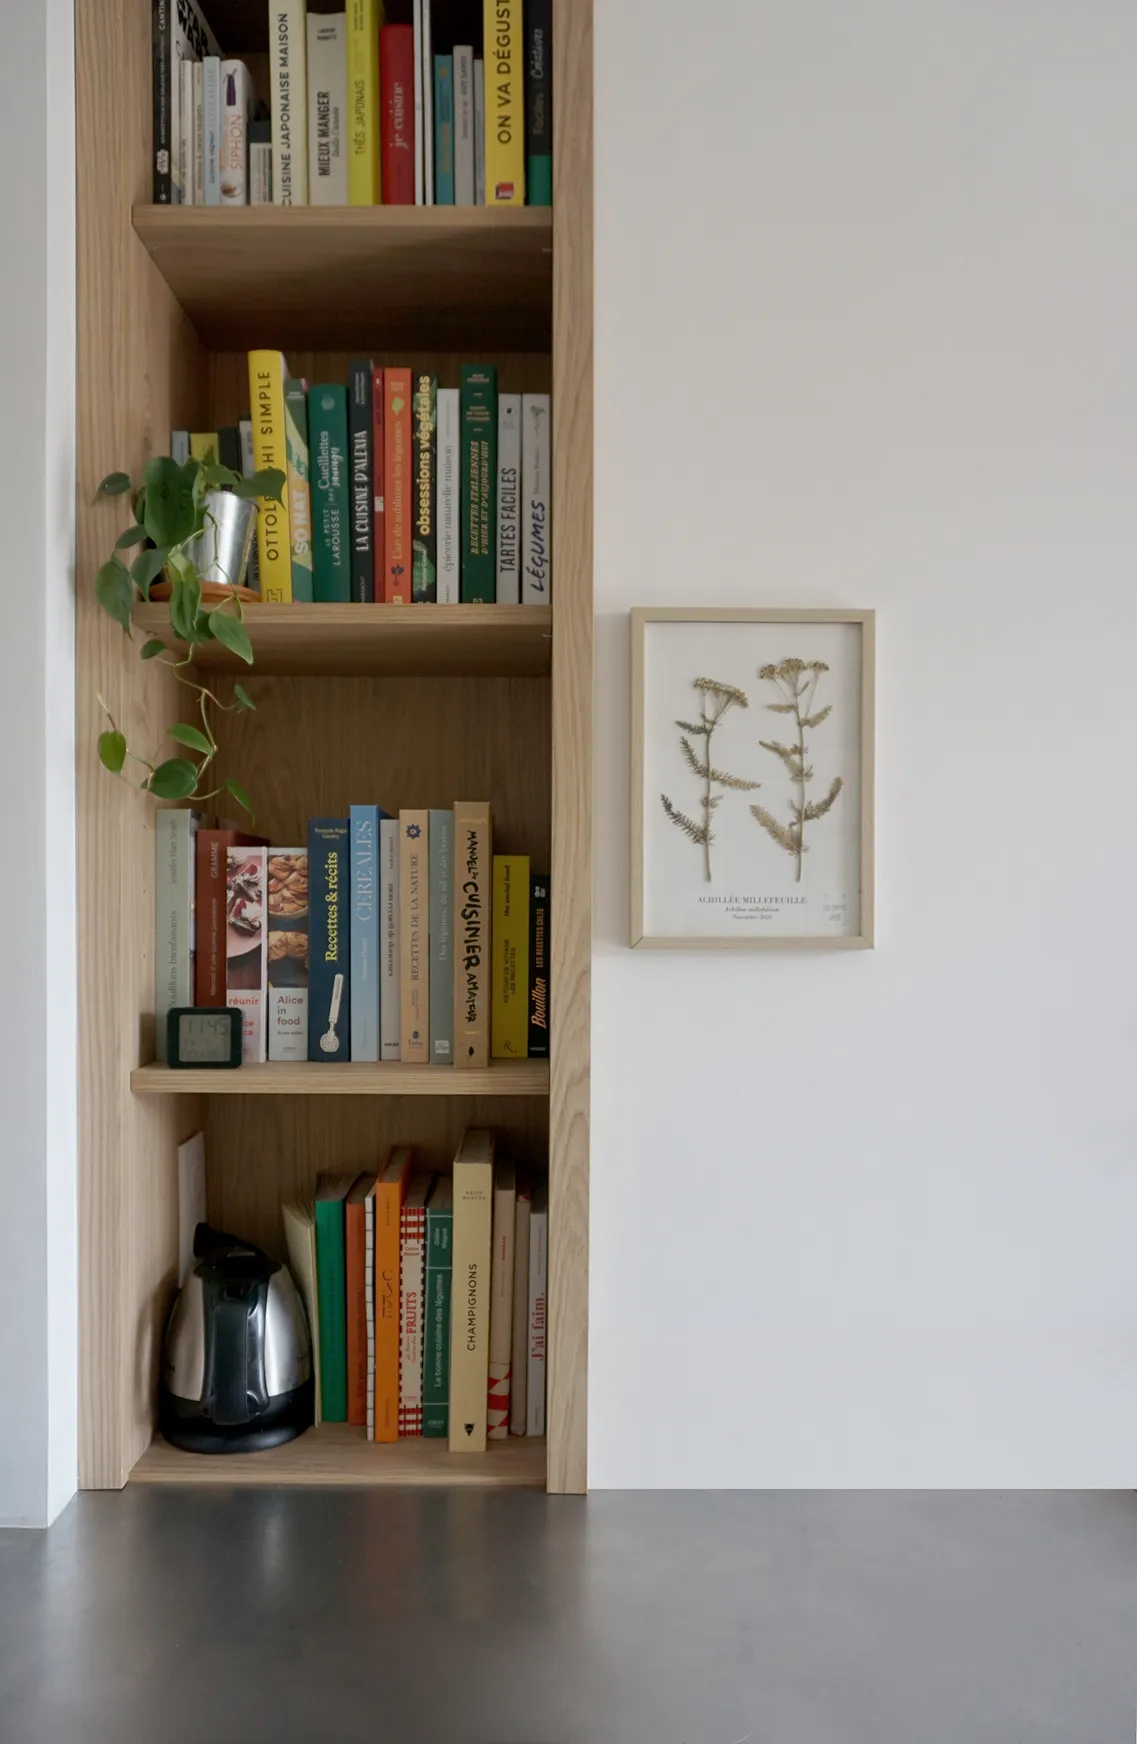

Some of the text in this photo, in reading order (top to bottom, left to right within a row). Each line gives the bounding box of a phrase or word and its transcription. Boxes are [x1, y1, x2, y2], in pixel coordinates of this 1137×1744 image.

[277, 13, 290, 68] MAISON
[279, 71, 291, 150] JAPONAISE
[353, 79, 365, 128] JAPONAIS
[496, 81, 511, 113] VA
[230, 113, 242, 170] SIPHON
[316, 91, 331, 177] MIEUX MANGER
[353, 128, 365, 155] THÉS
[389, 132, 408, 149] je
[496, 115, 512, 144] ON
[256, 371, 273, 434] SIMPLE
[415, 375, 433, 450] végétales
[318, 430, 329, 490] Cueillettes
[353, 430, 370, 552] LA CUISINE D'ALEXIA
[416, 451, 430, 536] obsessions
[469, 440, 479, 555] RECETTES ITALIENNES
[330, 508, 341, 567] LAROUSSE
[481, 510, 489, 527] ET
[499, 467, 517, 573] TARTES FACILES
[294, 529, 309, 556] SO
[441, 527, 454, 572] épicerie
[525, 500, 549, 593] LÉGUMES
[210, 841, 219, 878] GRAMME
[409, 852, 419, 895] NATURE
[437, 854, 447, 868] des
[466, 830, 478, 873] MANUEL
[323, 851, 338, 962] Recettes & récits
[410, 896, 419, 911] LA
[410, 913, 419, 928] DE
[438, 893, 447, 905] du
[697, 894, 807, 905] ACHILLÉE MILLEFEUILLE
[460, 880, 482, 971] CUISINIER
[535, 926, 544, 956] RECETTES
[410, 931, 420, 981] RECETTES
[438, 944, 448, 961] Des
[502, 938, 510, 1004] RETOUR DE VOYAGE
[509, 946, 517, 995] LES RECETTES
[535, 956, 545, 968] LES
[228, 996, 260, 1006] réunir
[277, 996, 304, 1005] Alice
[277, 1006, 287, 1015] in
[465, 972, 479, 1024] AMATEUR
[531, 976, 547, 1030] Bouillon
[277, 1016, 301, 1026] food
[406, 1291, 417, 1335] FRUITS
[433, 1273, 446, 1387] La bonne cuisine des légumes
[466, 1263, 478, 1352] CHAMPIGNONS
[531, 1329, 545, 1362] J'ai
